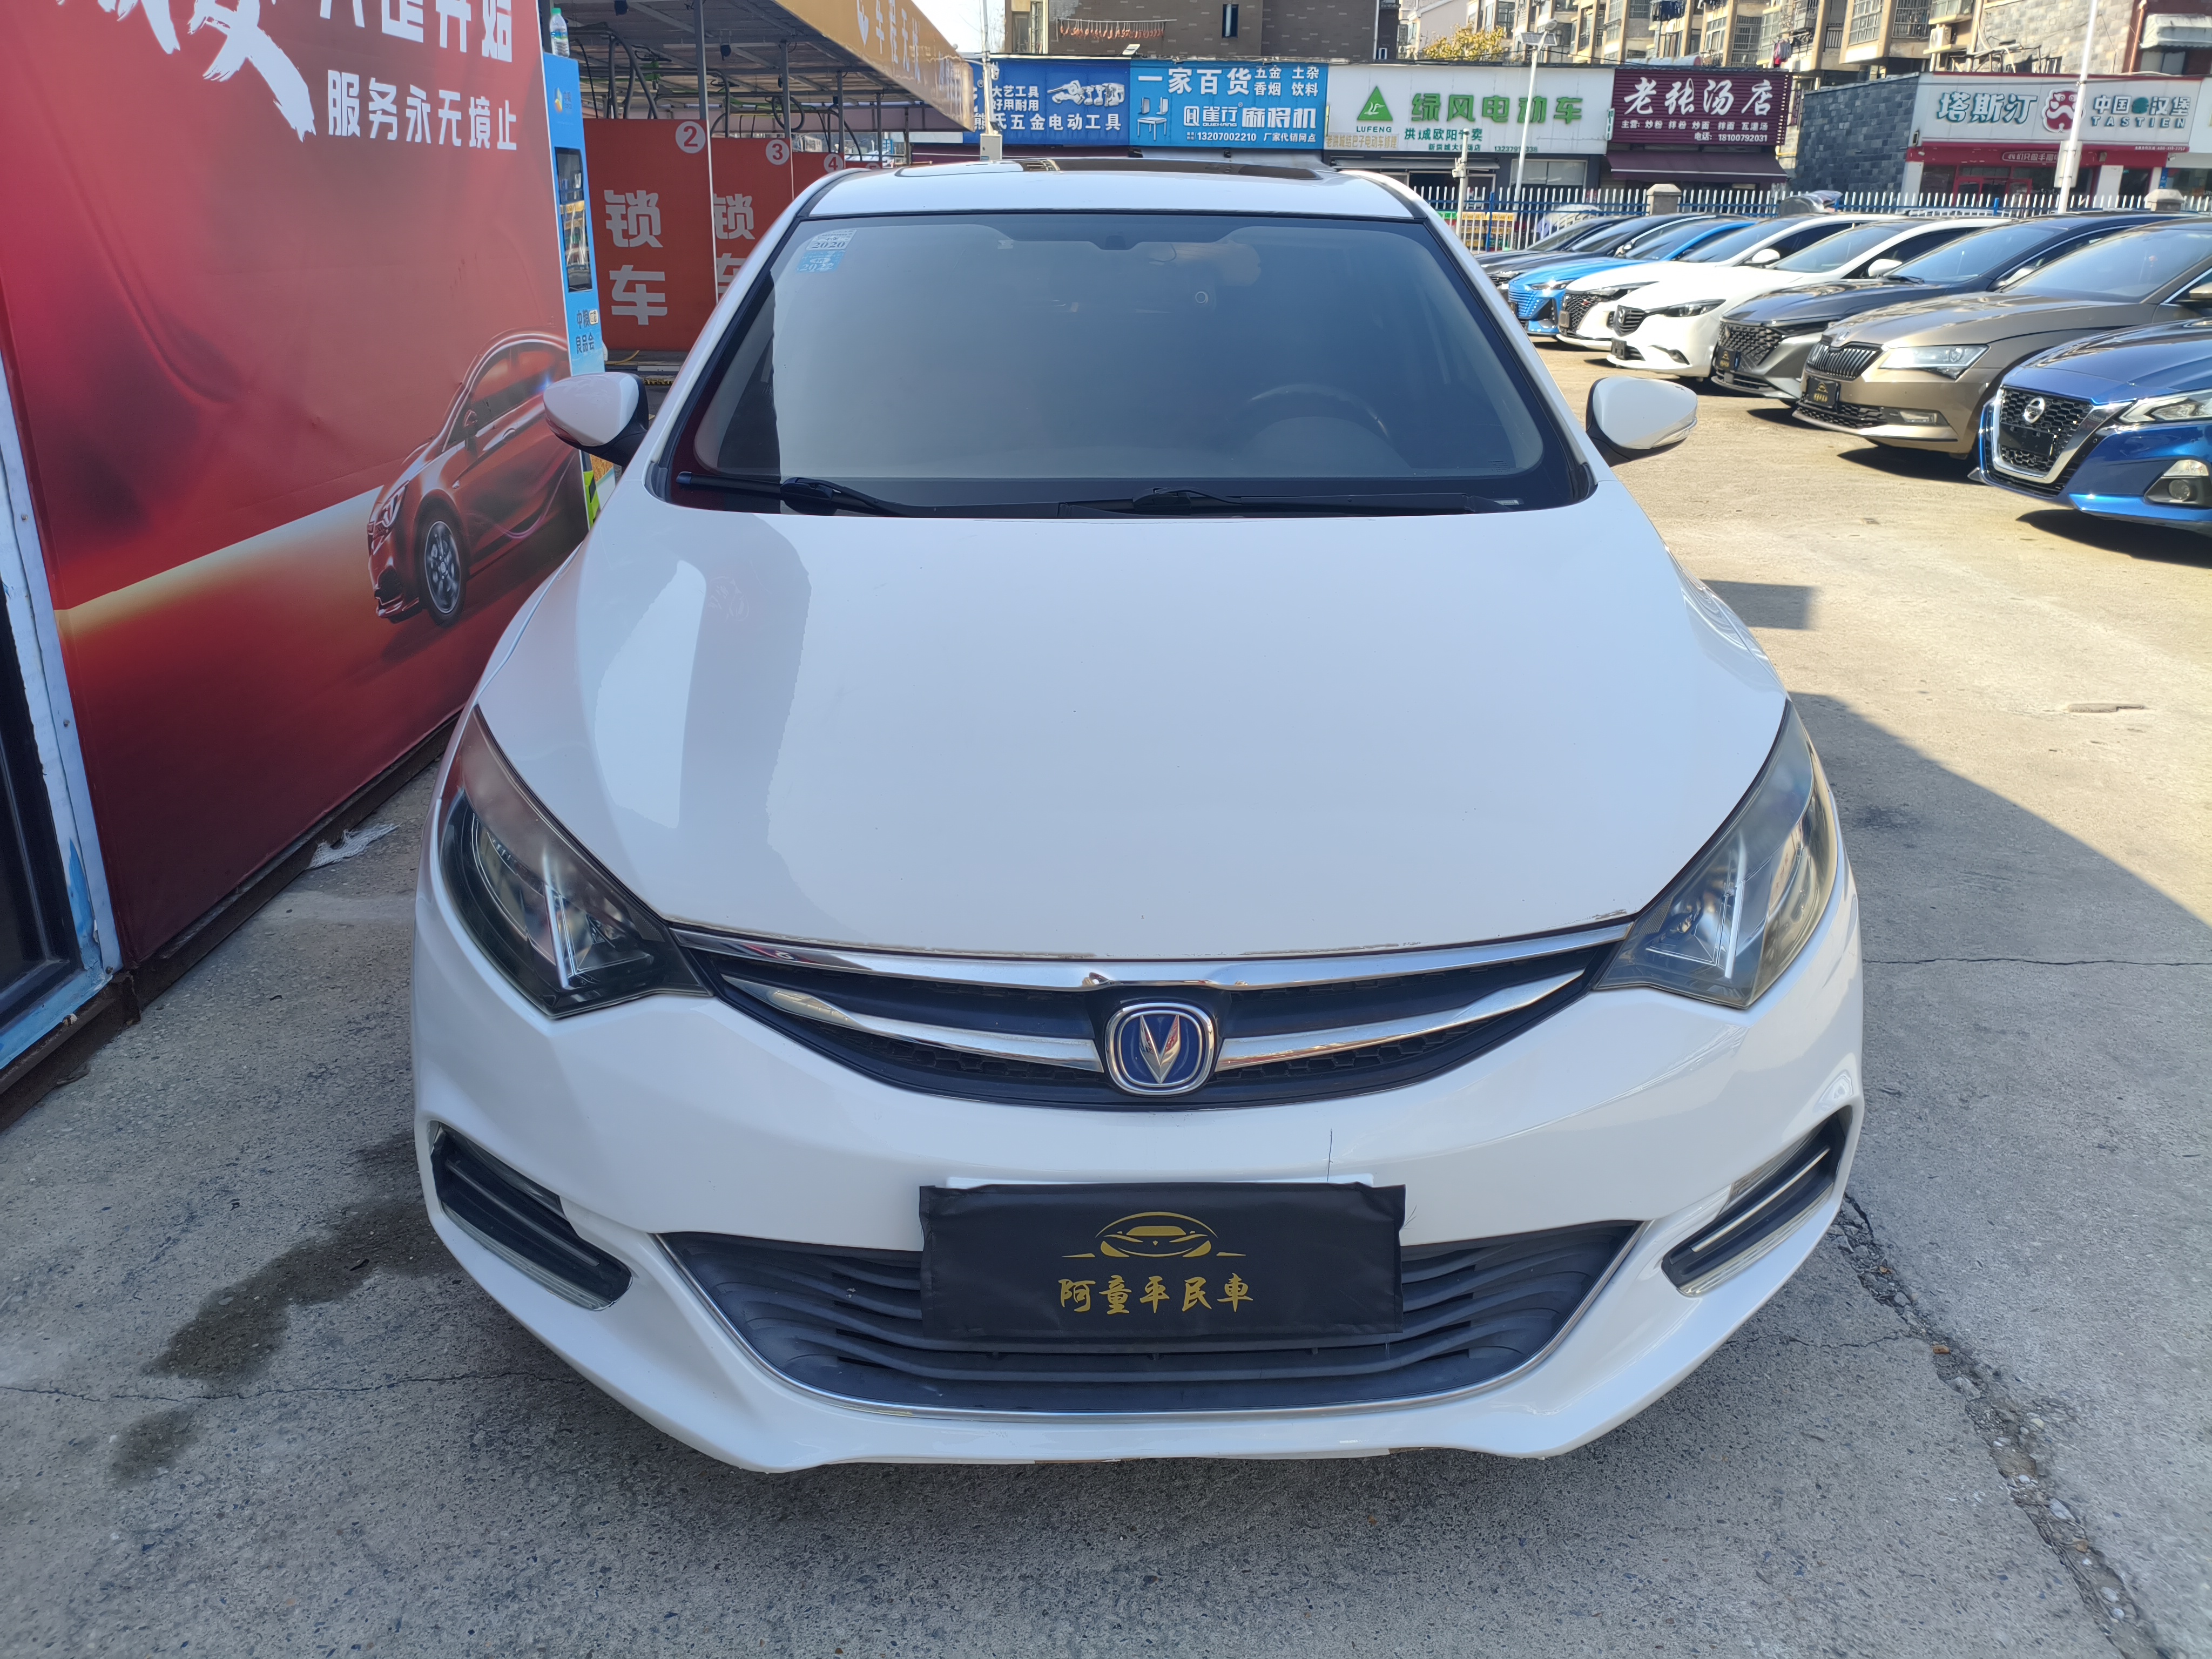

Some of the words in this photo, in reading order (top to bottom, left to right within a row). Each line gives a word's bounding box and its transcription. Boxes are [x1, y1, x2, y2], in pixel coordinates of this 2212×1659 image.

[1138, 67, 1252, 95] 一家百货
[1255, 65, 1282, 79] 五金
[1292, 65, 1319, 79] 土杂
[992, 85, 1040, 98] 大艺工具
[1254, 82, 1282, 96] 香烟
[1291, 82, 1318, 97] 饮料
[1623, 77, 1773, 116] 老张汤店
[328, 70, 517, 150] 服务永无境止
[993, 99, 1040, 111] 好用耐用
[1411, 93, 1583, 124] 绿风电动车
[1937, 92, 2038, 124] 塔斯汀
[2093, 95, 2132, 115] 中国
[2150, 96, 2190, 116] 汉堡
[974, 112, 1122, 131] 熊氏五金电动工具
[1242, 107, 1317, 129] 麻将机
[2091, 116, 2187, 129] TASTIEN
[683, 125, 698, 147] 2
[1197, 132, 1257, 141] 13207002210
[1263, 133, 1316, 143] 厂家代销网点
[1718, 133, 1768, 142] 18100792031
[772, 143, 784, 161] 3
[828, 156, 839, 171] 4
[604, 190, 668, 326] 锁车
